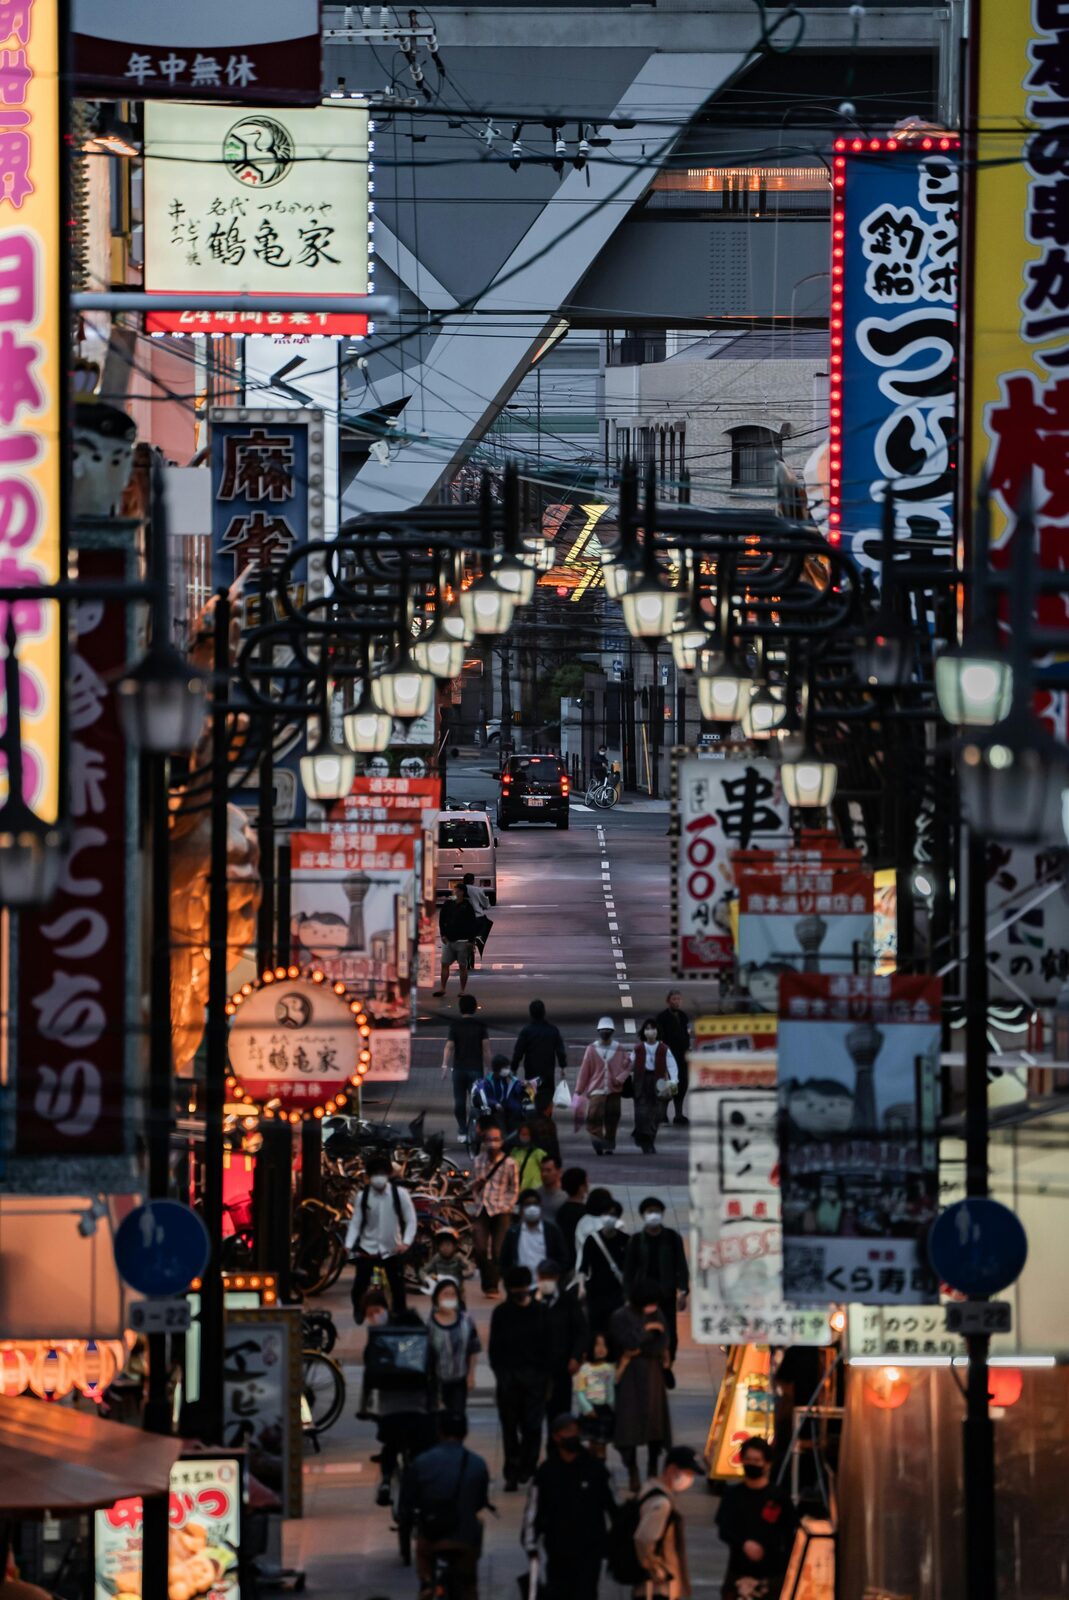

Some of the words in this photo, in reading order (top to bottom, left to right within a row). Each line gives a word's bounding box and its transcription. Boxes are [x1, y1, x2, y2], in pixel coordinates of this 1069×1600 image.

[124, 52, 258, 88] 年中無休
[206, 216, 341, 268] 鶴亀家
[862, 210, 925, 296] 釣船
[216, 428, 297, 588] 麻雀
[884, 1317, 947, 1333] カウン
